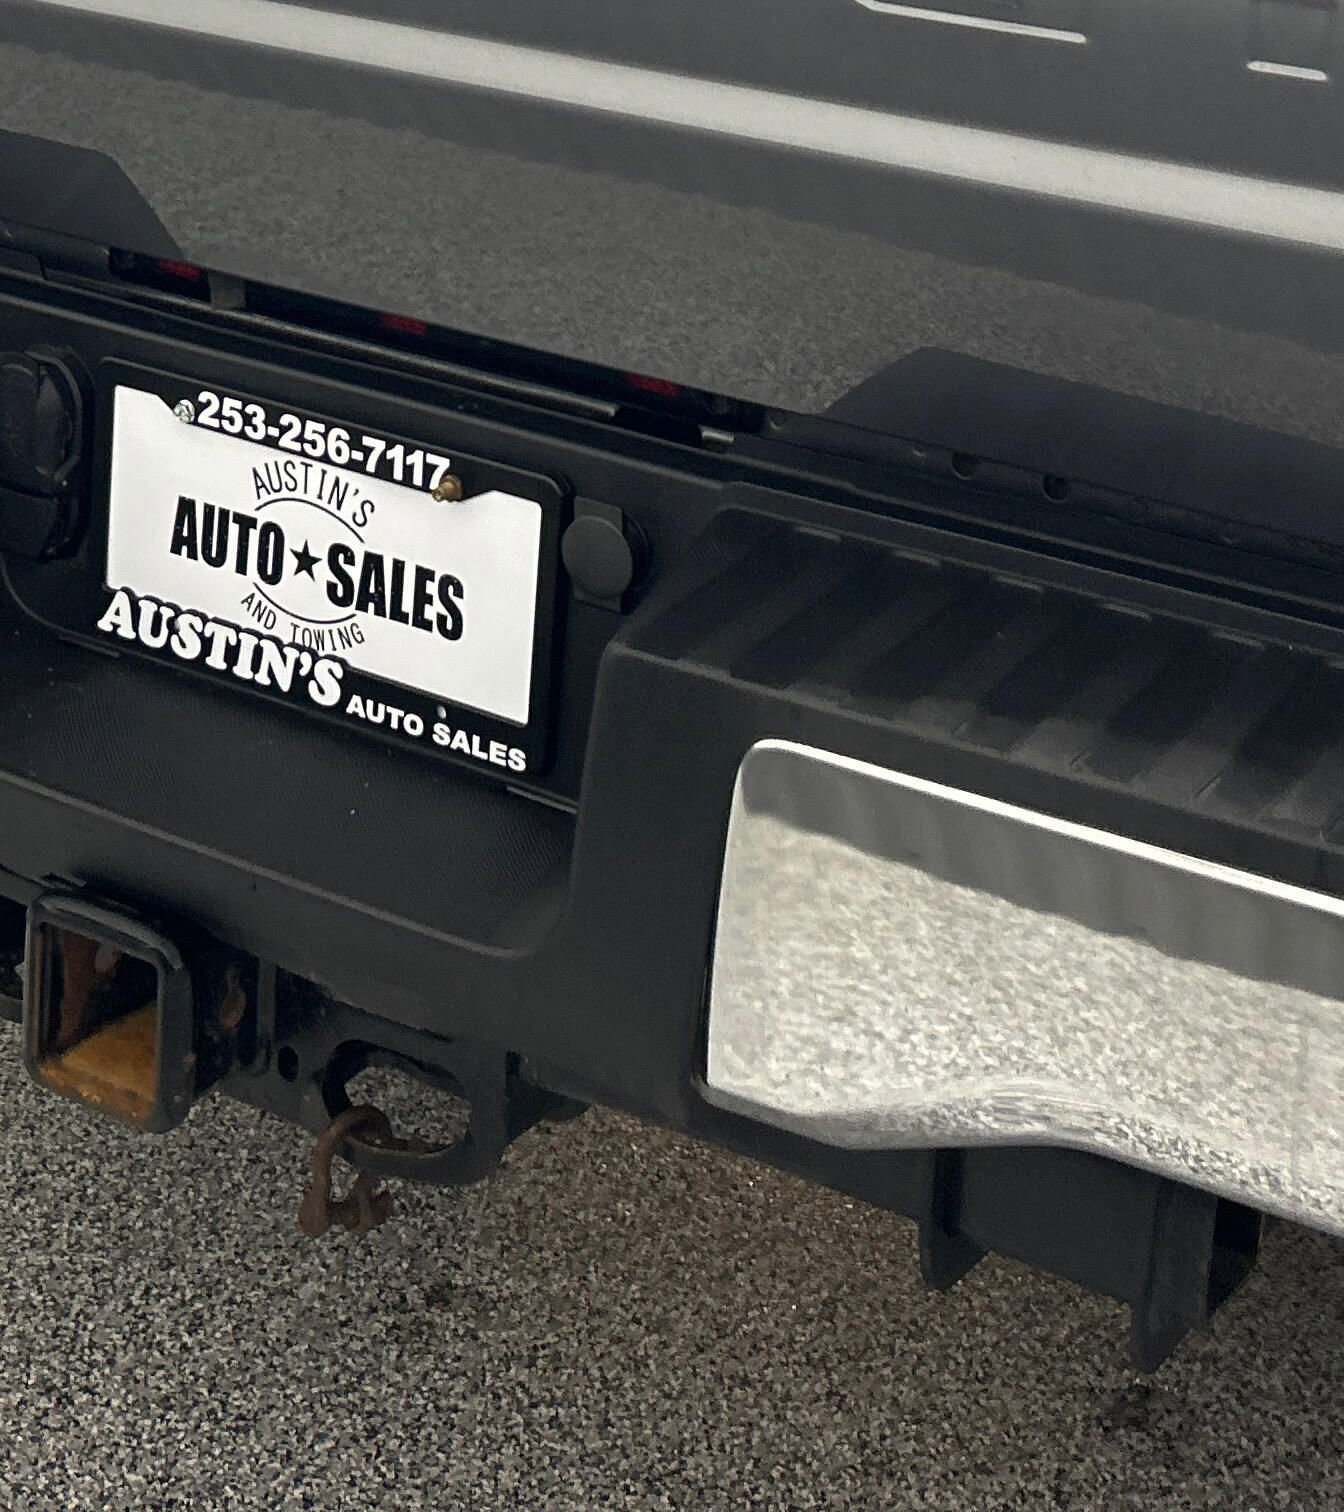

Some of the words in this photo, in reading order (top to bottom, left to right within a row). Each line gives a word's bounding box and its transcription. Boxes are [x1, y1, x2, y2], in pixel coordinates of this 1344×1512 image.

[197, 391, 451, 490] 253-256-7117
[252, 460, 376, 528] AUSTIN'S
[170, 495, 285, 587] AUTO
[326, 542, 464, 642] SALES
[240, 592, 277, 631] AND
[290, 622, 365, 652] TOWING
[97, 590, 343, 708] AUSTIN'S
[346, 695, 424, 737] AUTO
[432, 722, 526, 772] SALES
